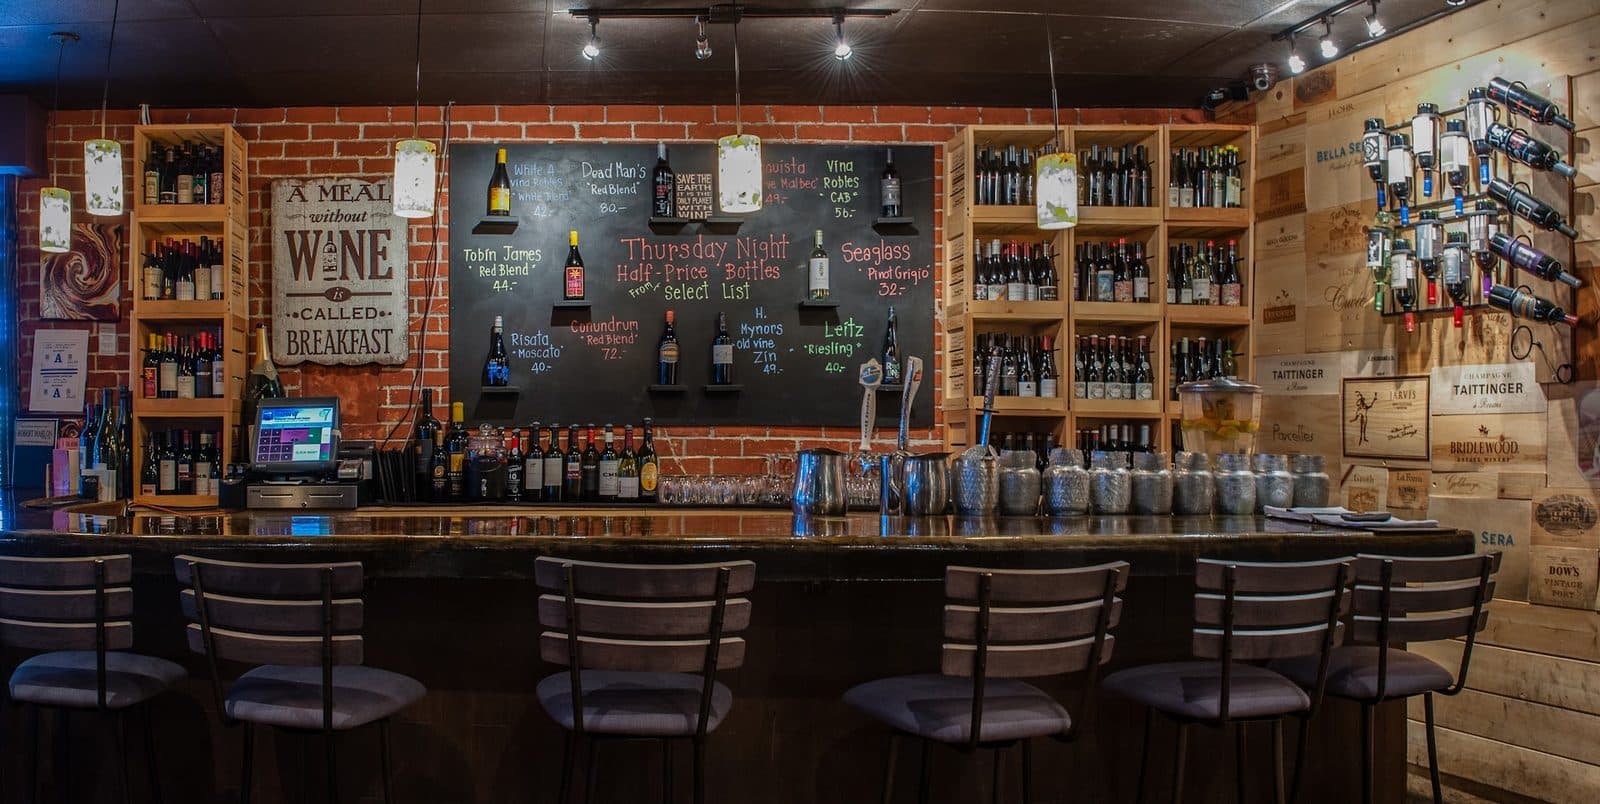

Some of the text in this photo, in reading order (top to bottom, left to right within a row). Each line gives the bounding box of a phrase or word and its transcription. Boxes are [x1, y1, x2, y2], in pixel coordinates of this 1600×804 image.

[1316, 146, 1346, 163] BELLA
[514, 163, 543, 176] White
[581, 161, 647, 179] Dead Man's
[676, 173, 713, 184] SAVE THE
[823, 175, 860, 189] Robles
[286, 183, 392, 203] A MEAL
[308, 208, 369, 224] without
[463, 245, 542, 263] Tobin James
[620, 233, 790, 267] Thursday Night
[840, 239, 911, 265] Seaglass
[616, 258, 781, 283] Half-Price Bottles
[332, 287, 344, 301] is
[664, 280, 710, 301] Select
[721, 281, 751, 300] List
[300, 306, 378, 321] CALLED
[755, 306, 768, 320] H.
[569, 315, 640, 333] Conundrum
[824, 316, 865, 338] Leitz
[286, 328, 394, 357] BREAKFAST
[510, 329, 549, 346] Risata
[752, 338, 776, 350] vine
[752, 350, 777, 365] Zin
[1272, 368, 1324, 381] TAITTINGER
[1464, 372, 1513, 380] CHAMPAGNE
[1390, 390, 1417, 400] JARVIS
[1453, 382, 1524, 396] TAITTINGER
[1450, 441, 1520, 455] BRIDLEWOOD
[1481, 530, 1514, 546] SERA
[1549, 565, 1580, 577] DOW'S
[1544, 579, 1583, 589] VINTAGE
[1551, 590, 1575, 599] PORT
